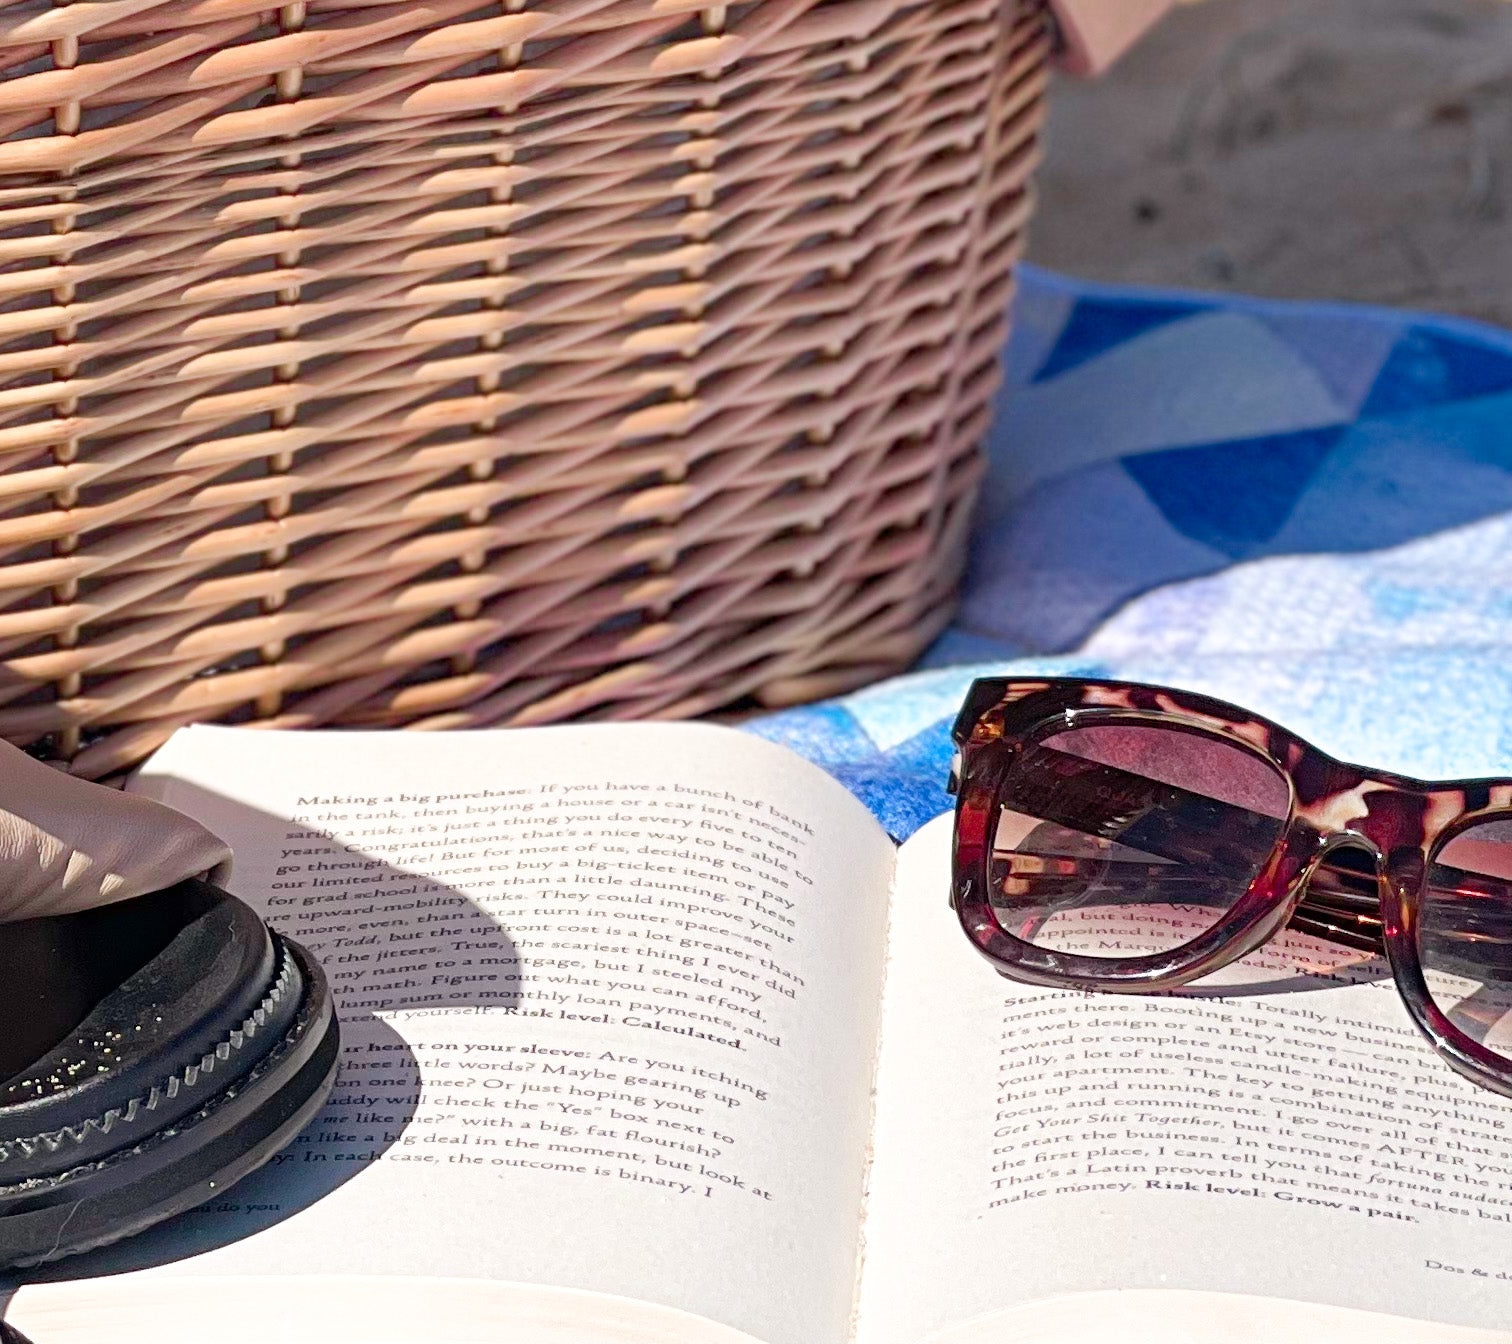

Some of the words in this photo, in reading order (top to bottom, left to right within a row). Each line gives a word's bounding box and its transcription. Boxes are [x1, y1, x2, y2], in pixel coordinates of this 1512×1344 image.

[297, 795, 378, 806] Making
[399, 794, 430, 803] big
[540, 784, 557, 793] If
[564, 784, 598, 793] you
[606, 782, 649, 791] have
[674, 784, 736, 802] bunch
[743, 798, 762, 809] of
[769, 806, 815, 836] bank
[340, 997, 392, 1011] lump
[399, 993, 444, 1005] sum
[449, 991, 473, 1000] or
[478, 990, 571, 1005] monthly
[577, 993, 622, 1008] loan
[629, 1001, 738, 1030] payments,
[743, 1026, 783, 1048] and
[431, 975, 497, 986] Figure
[504, 973, 540, 983] out
[547, 974, 600, 987] what
[607, 980, 646, 991] you
[652, 985, 688, 998] can
[695, 993, 768, 1023] afford,
[504, 1006, 554, 1020] Risk
[560, 1010, 616, 1025] level:
[622, 1016, 747, 1052] Calculated.
[368, 1043, 426, 1052] heart
[431, 1043, 458, 1051] on
[463, 1044, 516, 1054] your
[519, 1043, 591, 1059] sleeve:
[599, 1051, 638, 1064] Are
[645, 1059, 684, 1073] you
[692, 1066, 769, 1101] itching
[368, 1078, 406, 1087] one
[414, 1077, 476, 1088] knee?
[483, 1078, 514, 1091] Or
[520, 1081, 563, 1096] just
[569, 1084, 646, 1106] hoping
[653, 1097, 704, 1116] your
[399, 1059, 450, 1069] little
[458, 1062, 536, 1072] words?
[542, 1064, 617, 1081] Maybe
[624, 1076, 708, 1099] gearing
[713, 1091, 741, 1109] up
[385, 1094, 427, 1105] will
[434, 1096, 496, 1109] check
[503, 1100, 539, 1111] the
[610, 1107, 648, 1124] box
[656, 1116, 705, 1137] next
[712, 1130, 735, 1145] to
[998, 1072, 1044, 1089] your
[1053, 1066, 1175, 1079] apartment.
[1183, 1067, 1227, 1082] The
[1236, 1074, 1273, 1089] key
[1281, 1081, 1304, 1092] to
[1311, 1088, 1395, 1109] getting
[1401, 1101, 1506, 1130] anything
[323, 1116, 350, 1125] me
[355, 1114, 394, 1125] like
[462, 1115, 513, 1129] with
[540, 1120, 579, 1136] big,
[586, 1125, 618, 1139] fat
[624, 1129, 723, 1160] flourish?
[993, 1123, 1029, 1137] Get
[1036, 1115, 1083, 1130] Your
[1087, 1113, 1128, 1123] Shit
[1137, 1113, 1226, 1129] Together,
[1233, 1120, 1273, 1134] but
[1279, 1127, 1295, 1136] it
[1301, 1131, 1371, 1150] comes
[1377, 1144, 1465, 1166] AFTER
[303, 1151, 327, 1162] In
[334, 1151, 383, 1162] each
[389, 1153, 440, 1166] case,
[449, 1154, 483, 1164] the
[491, 1157, 587, 1174] outcome
[595, 1165, 611, 1176] is
[619, 1168, 697, 1195] binary.
[704, 1186, 714, 1198] I
[318, 1131, 357, 1143] like
[383, 1132, 418, 1146] big
[423, 1134, 468, 1145] deal
[475, 1136, 496, 1146] in
[503, 1138, 540, 1150] the
[547, 1142, 647, 1164] moment,
[654, 1154, 696, 1173] but
[699, 1165, 745, 1190] look
[751, 1185, 773, 1202] at
[992, 1159, 1026, 1173] the
[1035, 1149, 1080, 1163] first
[1087, 1147, 1150, 1161] place,
[1157, 1147, 1165, 1156] I
[1174, 1148, 1213, 1159] can
[1222, 1152, 1257, 1164] tell
[1265, 1156, 1305, 1171] you
[1314, 1165, 1362, 1180] that
[988, 1188, 1047, 1209] make
[1146, 1180, 1200, 1192] Risk
[1205, 1183, 1266, 1198] level:
[1273, 1191, 1343, 1209] Grow
[1367, 1206, 1421, 1224] pair.
[1087, 1164, 1148, 1174] Latin
[1155, 1164, 1243, 1180] proverb
[1251, 1172, 1302, 1187] that
[1307, 1180, 1379, 1200] means
[1387, 1193, 1404, 1203] it
[1410, 1198, 1470, 1216] takes
[1425, 1260, 1465, 1275] Dos
